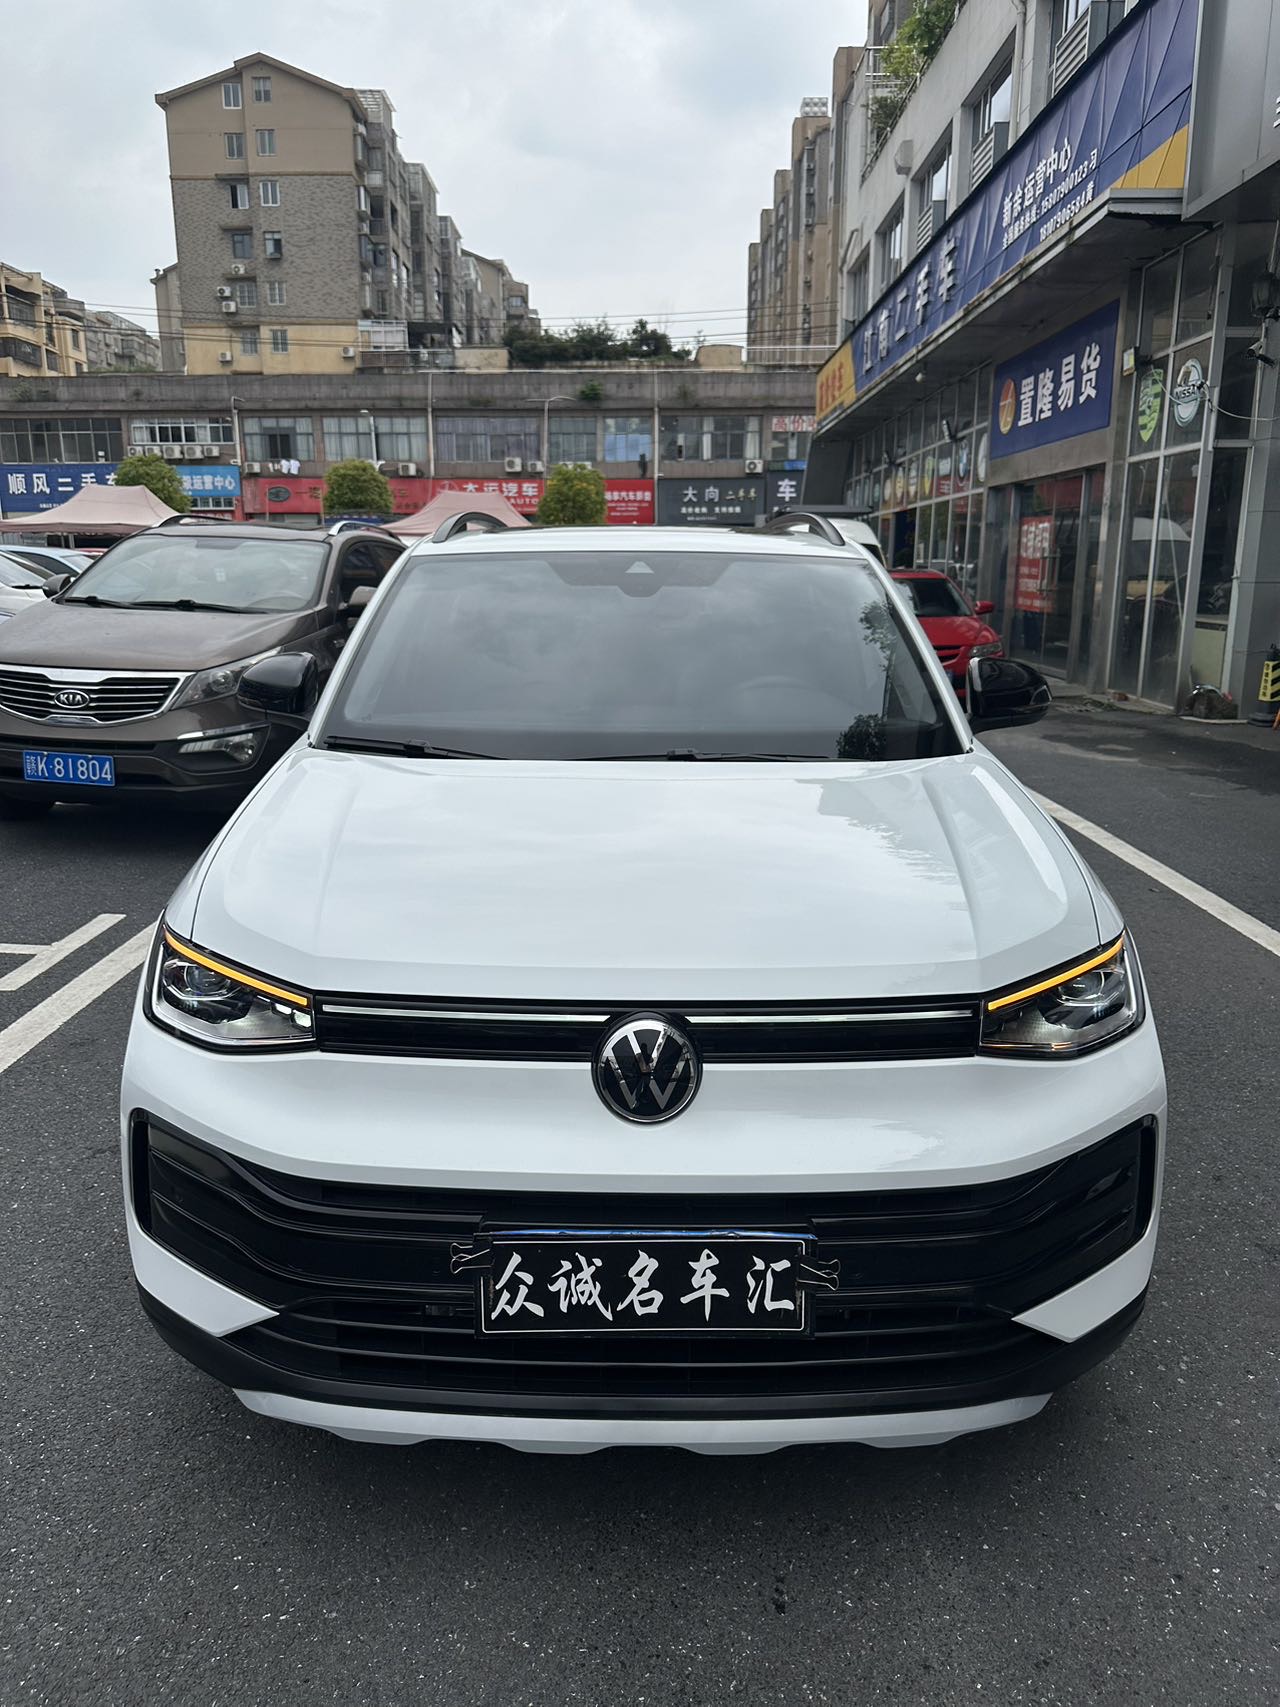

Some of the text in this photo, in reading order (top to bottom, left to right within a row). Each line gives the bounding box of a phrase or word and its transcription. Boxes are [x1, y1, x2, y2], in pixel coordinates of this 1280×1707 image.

[1002, 137, 1071, 227] 新余运营中心
[1018, 342, 1101, 426] 置隆易货
[683, 485, 719, 502] 大向
[776, 478, 797, 502] 车
[60, 694, 83, 704] KIA
[490, 1249, 796, 1322] 众诚名车汇
